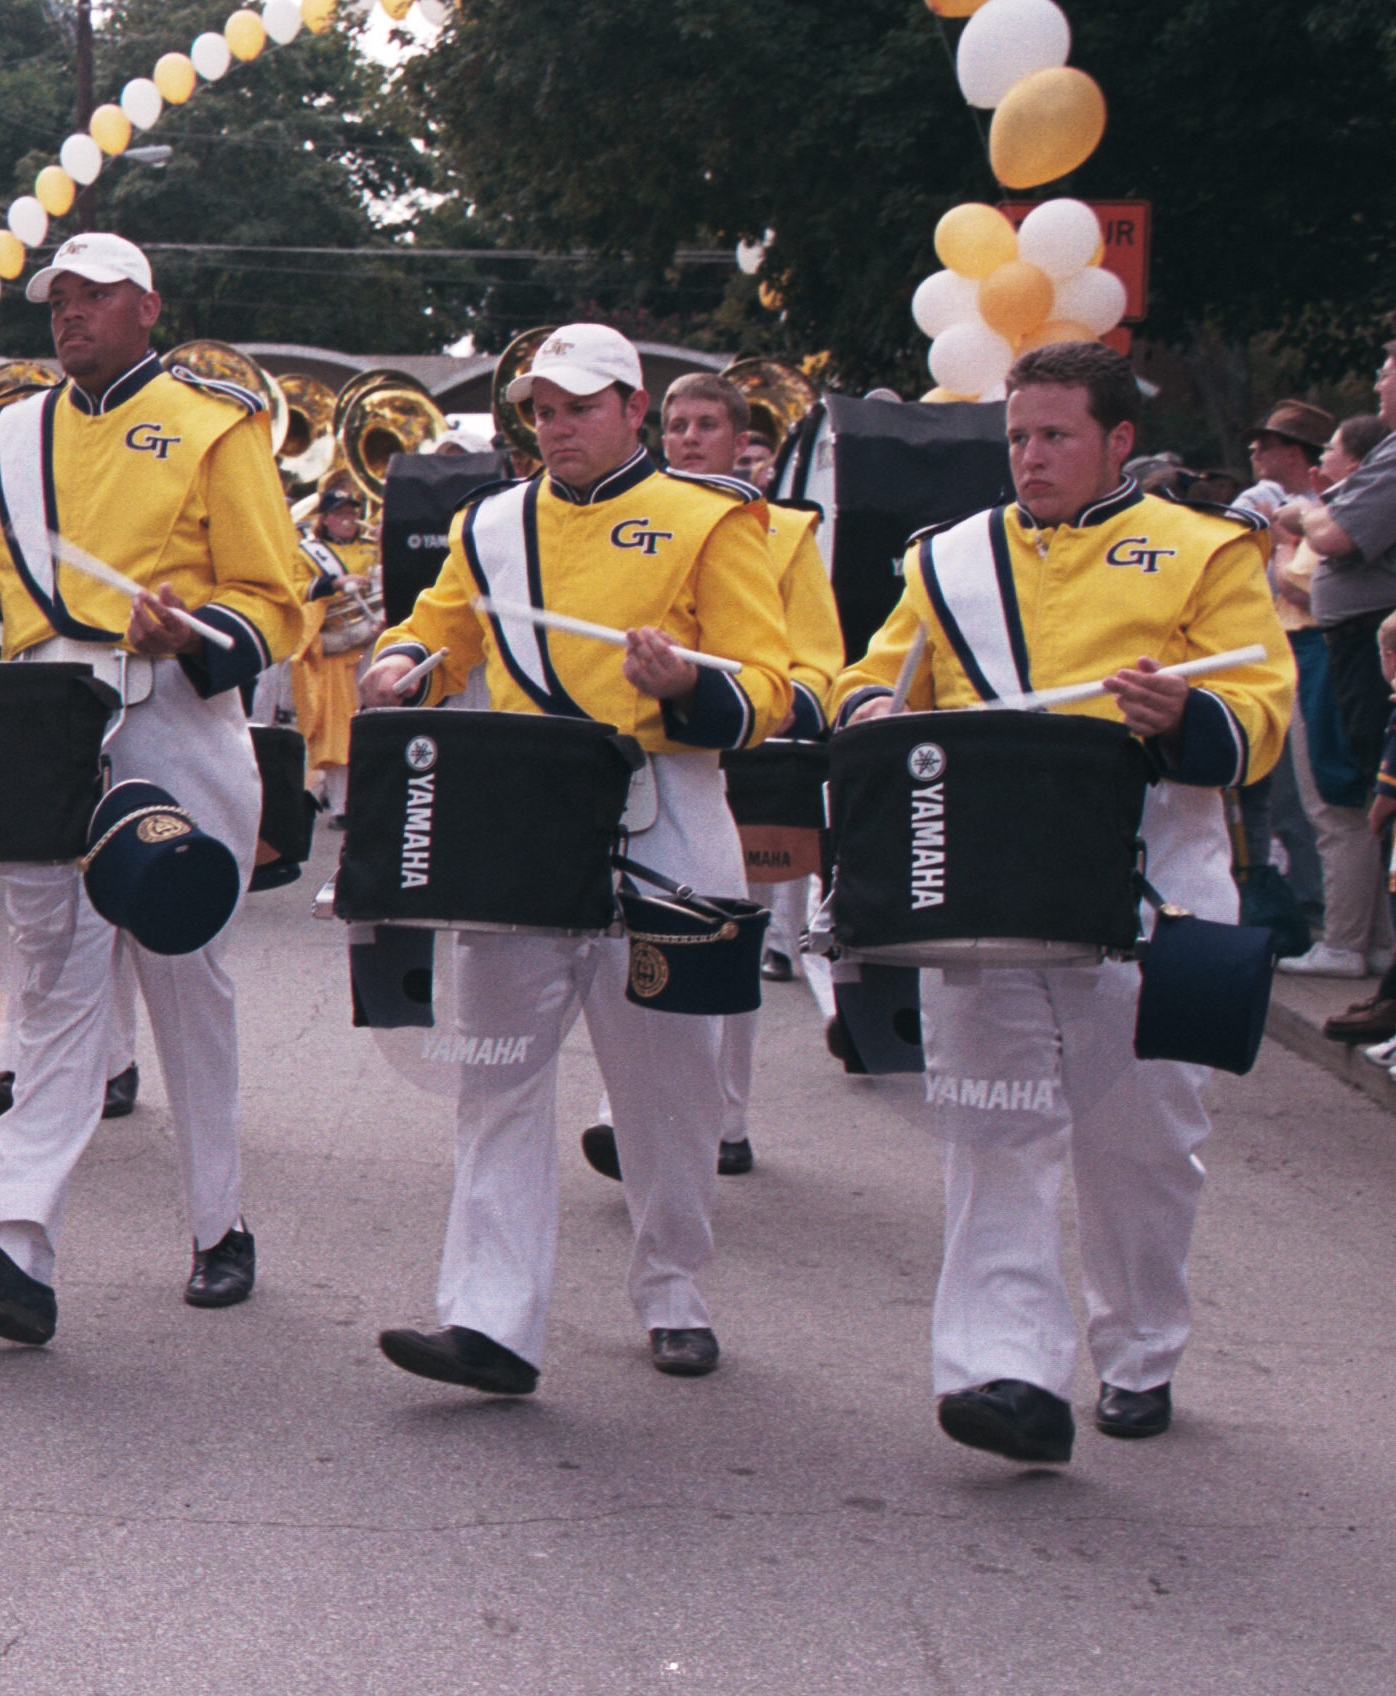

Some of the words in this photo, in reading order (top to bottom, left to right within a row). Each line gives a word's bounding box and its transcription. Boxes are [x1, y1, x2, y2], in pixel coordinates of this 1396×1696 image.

[125, 422, 181, 459] GT
[610, 517, 673, 555] GT
[1106, 536, 1176, 573] GT
[400, 773, 435, 888] YAMAHA
[910, 782, 945, 910] YAMAHA
[420, 1034, 529, 1066] YAMAHA
[922, 1072, 1055, 1111] YAMAHA
